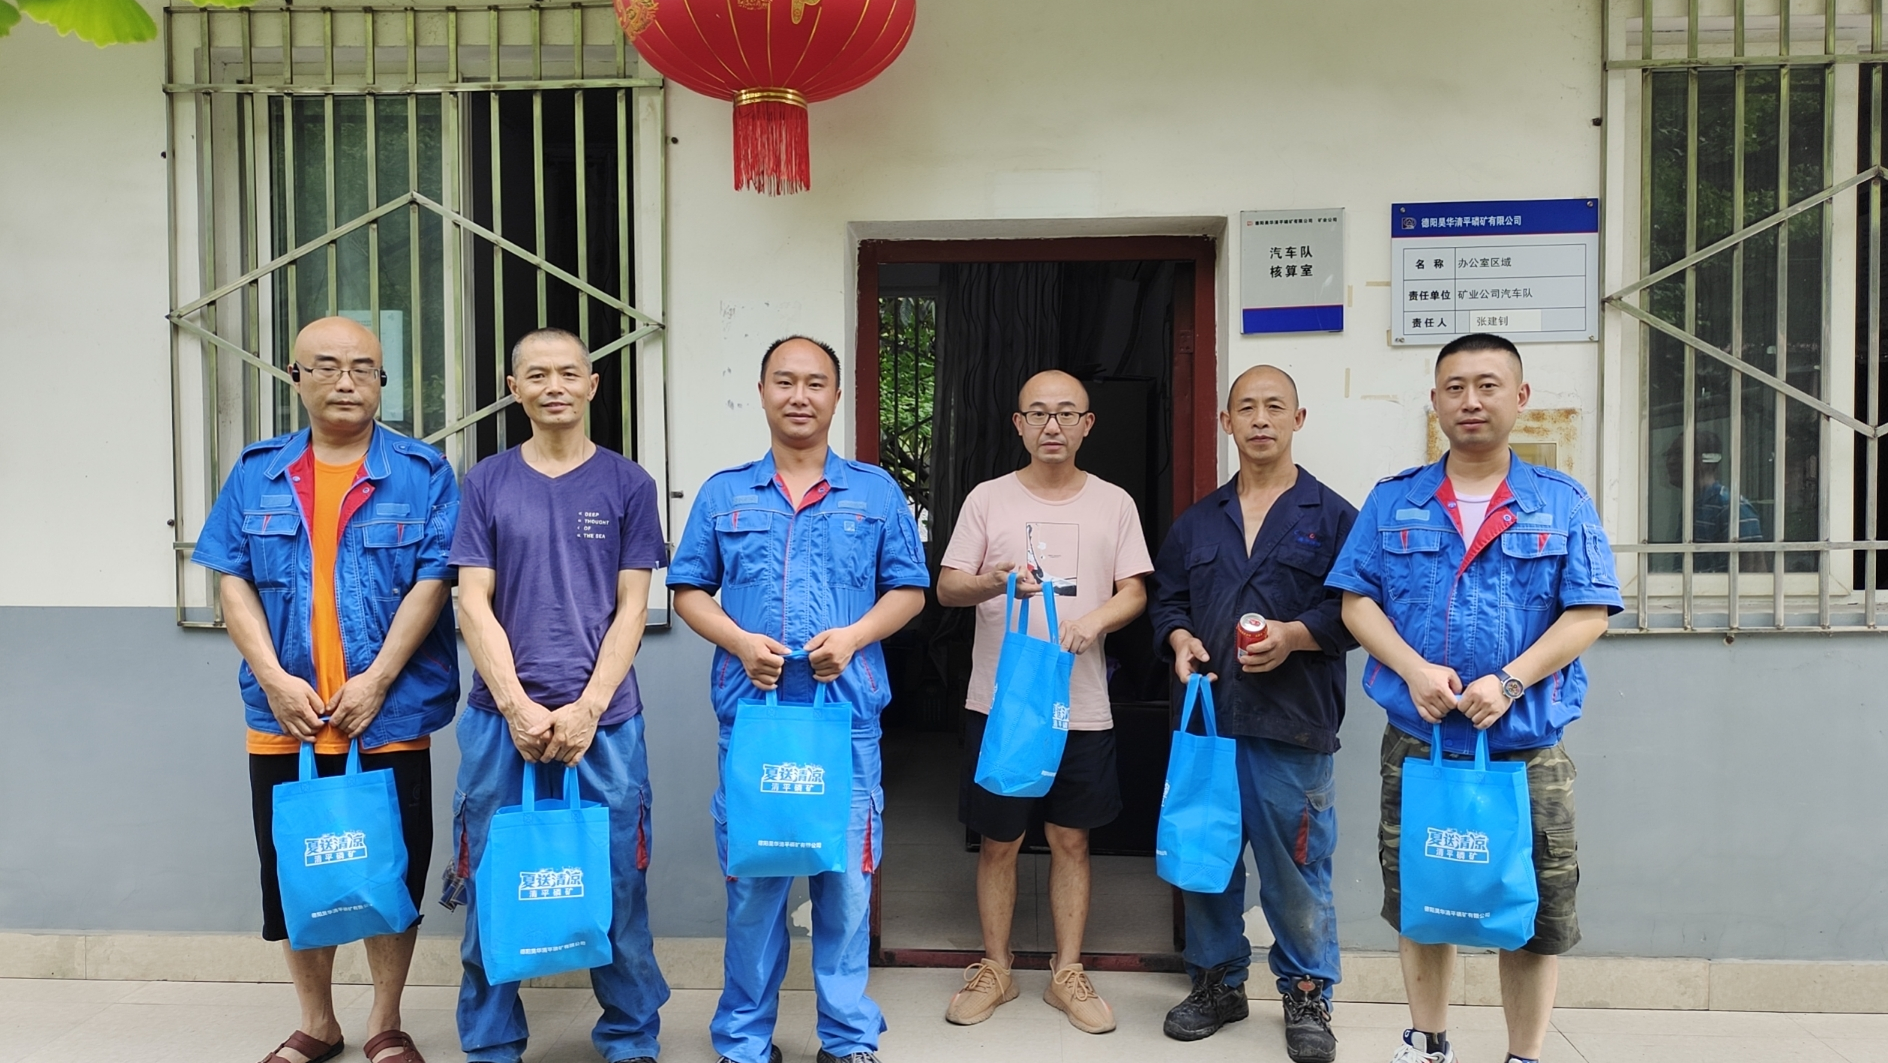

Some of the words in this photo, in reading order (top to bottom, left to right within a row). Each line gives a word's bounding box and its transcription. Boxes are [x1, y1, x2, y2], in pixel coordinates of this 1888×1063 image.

[1421, 215, 1522, 228] 德阳昊华清平磷矿有限公司
[1269, 245, 1313, 259] 汽车队
[1415, 258, 1444, 270] 名称
[1458, 257, 1512, 269] 办公室区域
[1269, 264, 1313, 278] 核算室
[1408, 290, 1451, 301] 责任单位
[1457, 288, 1533, 300] 矿业公司汽车队
[1411, 317, 1447, 328] 责任人
[763, 764, 824, 783] 夏送清凉
[305, 832, 366, 855] 夏送清凉
[1427, 830, 1487, 850] 夏送清凉
[520, 870, 582, 888] 夏送清凉
